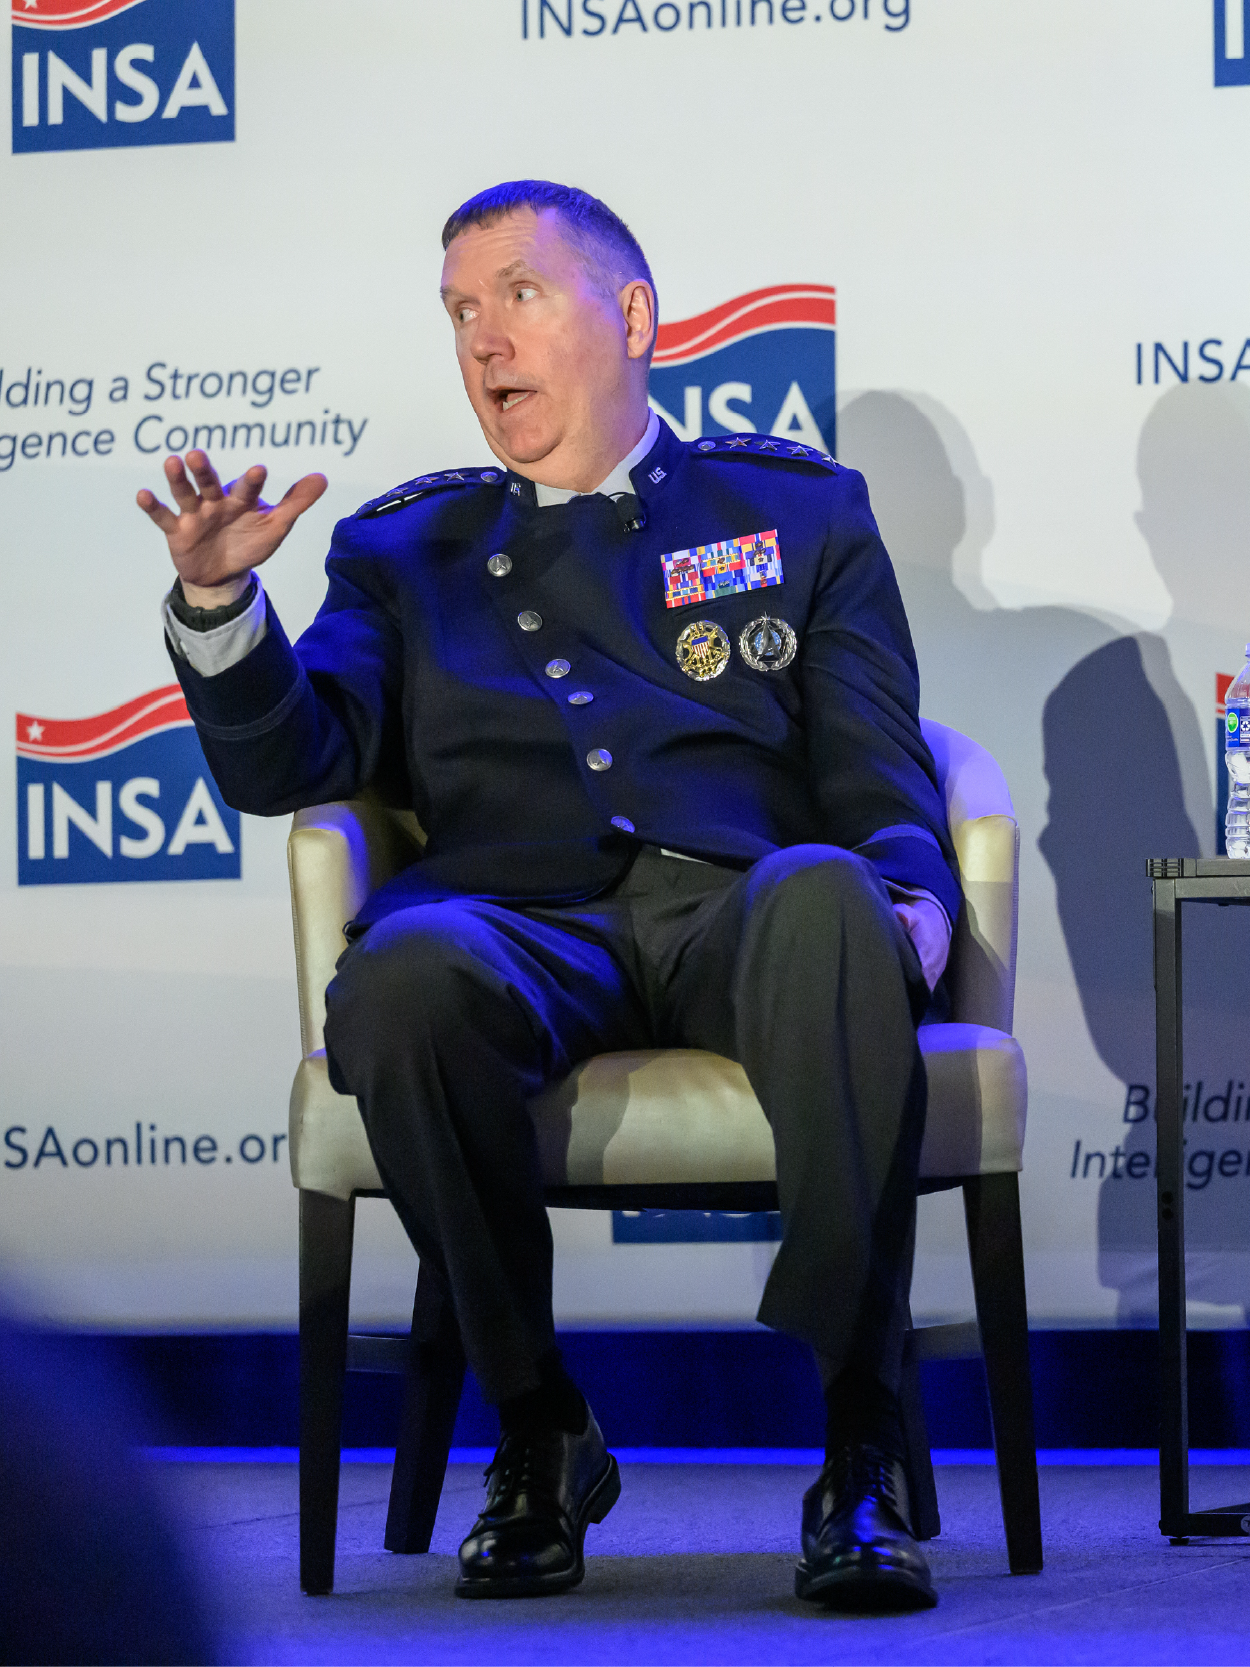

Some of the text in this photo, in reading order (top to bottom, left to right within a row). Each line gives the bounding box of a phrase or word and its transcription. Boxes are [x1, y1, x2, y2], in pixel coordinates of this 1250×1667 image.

[522, 0, 911, 40] INSAonline.org
[22, 40, 229, 127] INSA
[109, 376, 129, 402] a
[143, 362, 320, 408] Stronger
[134, 408, 368, 457] Community
[648, 381, 829, 451] NSA
[648, 466, 667, 484] US
[27, 776, 235, 860] INSA
